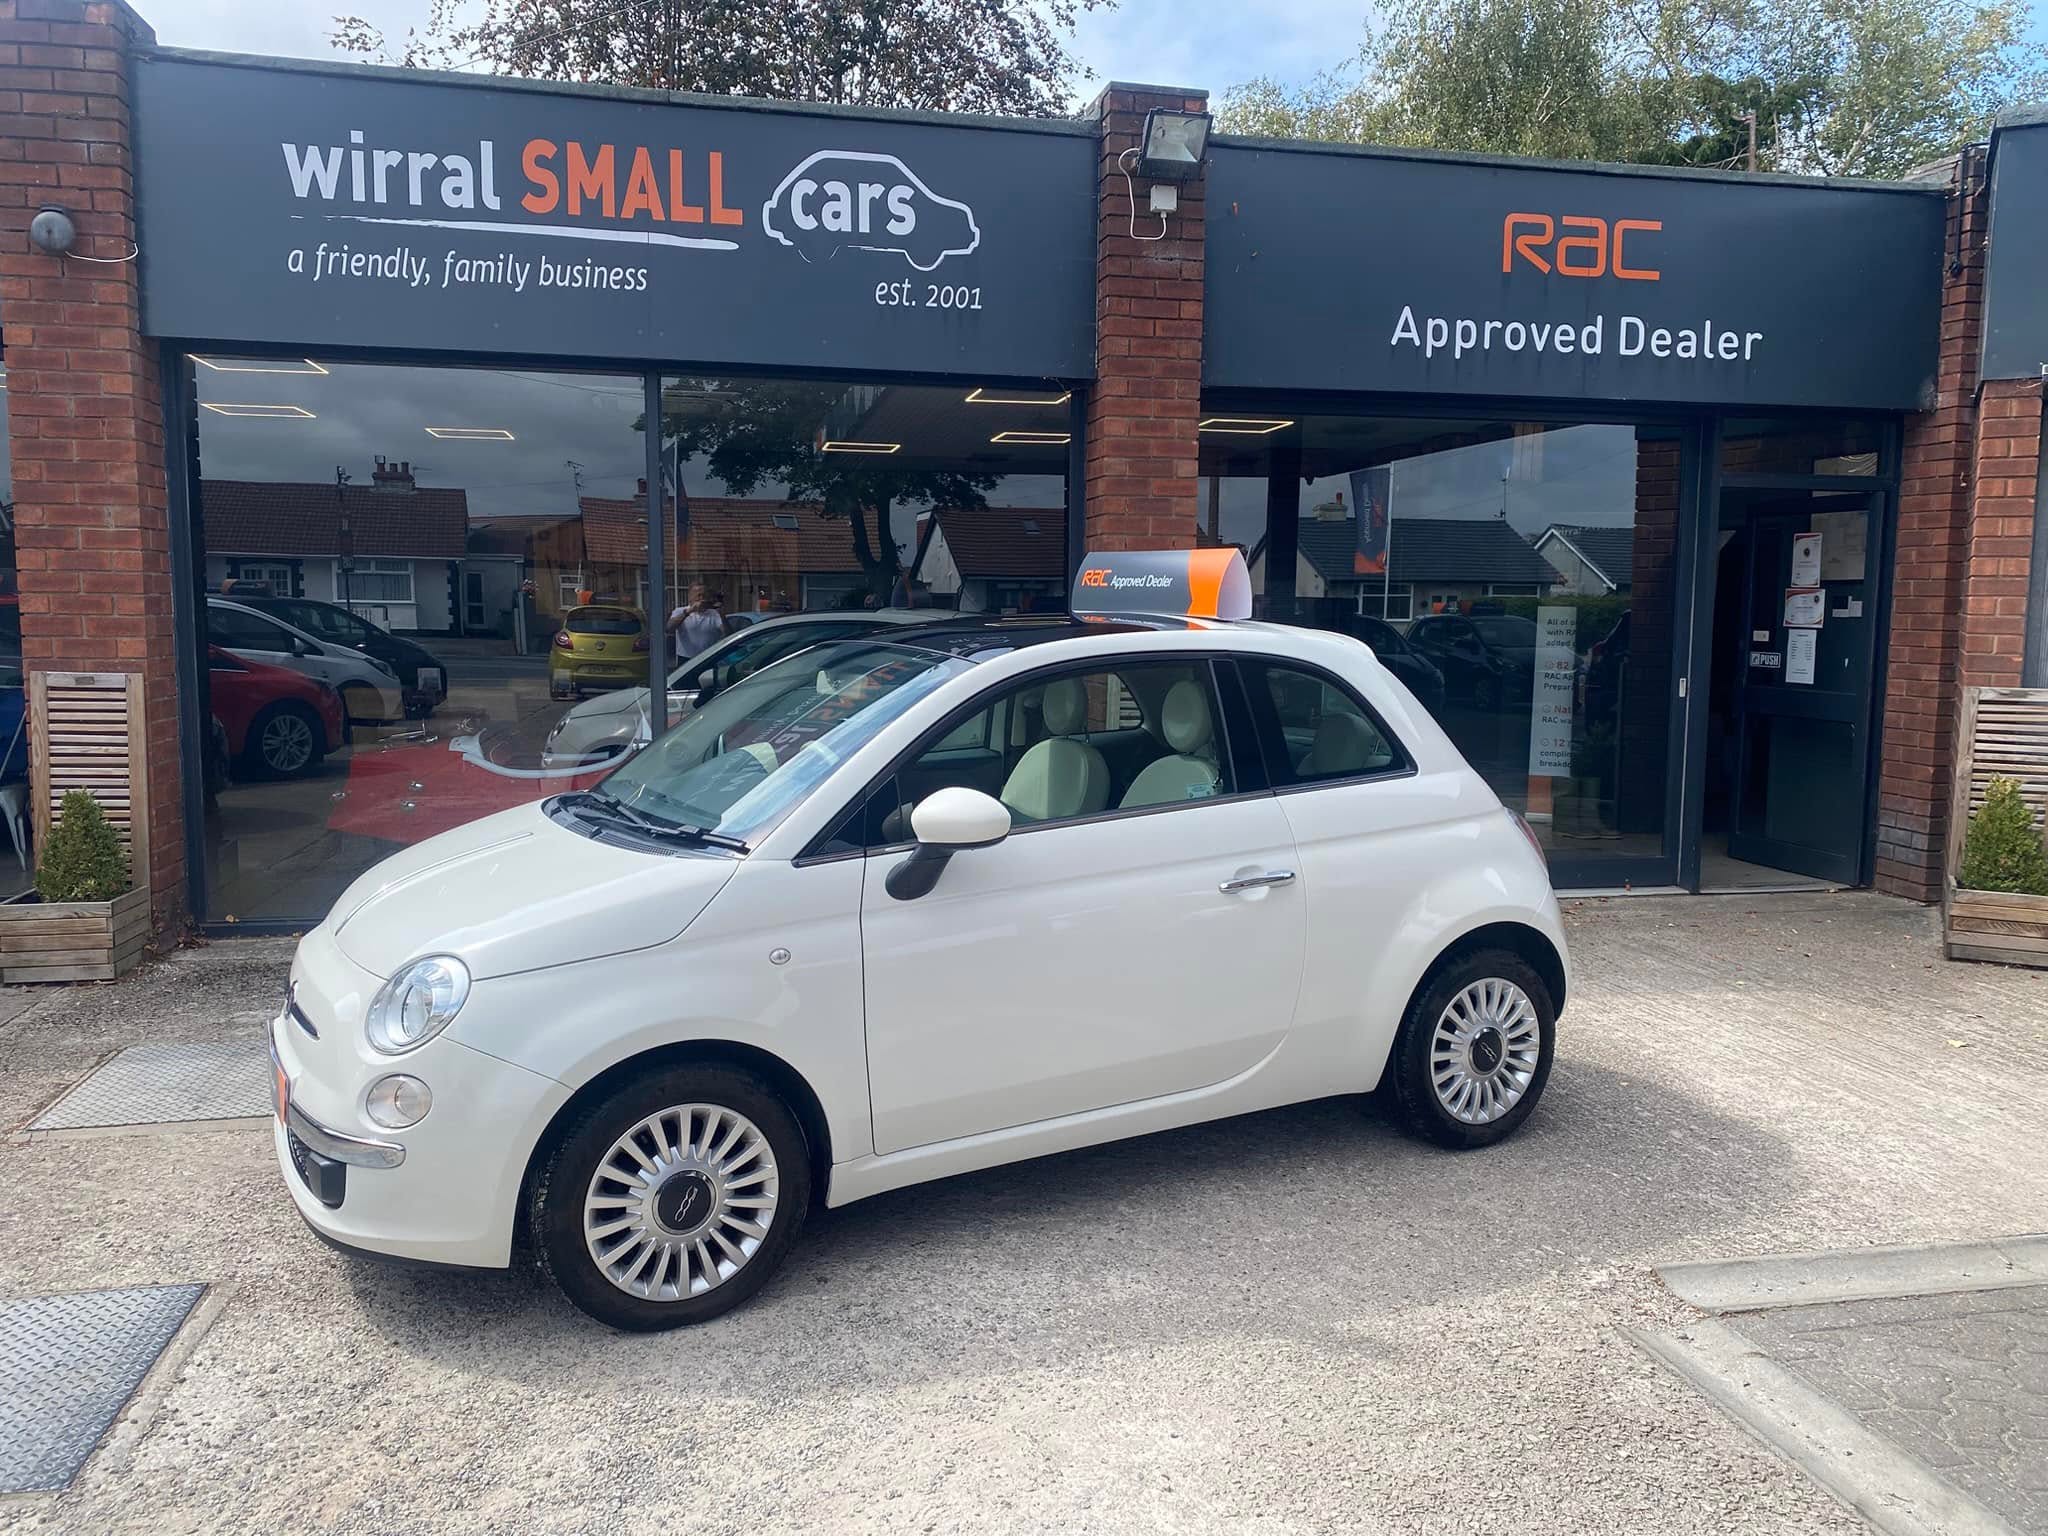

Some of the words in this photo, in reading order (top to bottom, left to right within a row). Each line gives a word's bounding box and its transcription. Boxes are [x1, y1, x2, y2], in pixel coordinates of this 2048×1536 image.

[281, 130, 501, 210] wirral
[520, 139, 743, 225] SMALL
[791, 178, 916, 236] cars
[288, 249, 304, 273] a
[313, 243, 431, 287] friendly,
[442, 250, 530, 292] family
[538, 254, 647, 290] business
[875, 278, 916, 306] est.
[925, 284, 982, 310] 2001
[1391, 305, 1603, 359] Approved
[1619, 316, 1763, 360] Dealer
[1110, 575, 1146, 589] Approved
[1146, 574, 1173, 587] Dealer
[1760, 654, 1779, 665] PUSH
[1544, 672, 1561, 680] RAC
[1542, 716, 1558, 724] RAC
